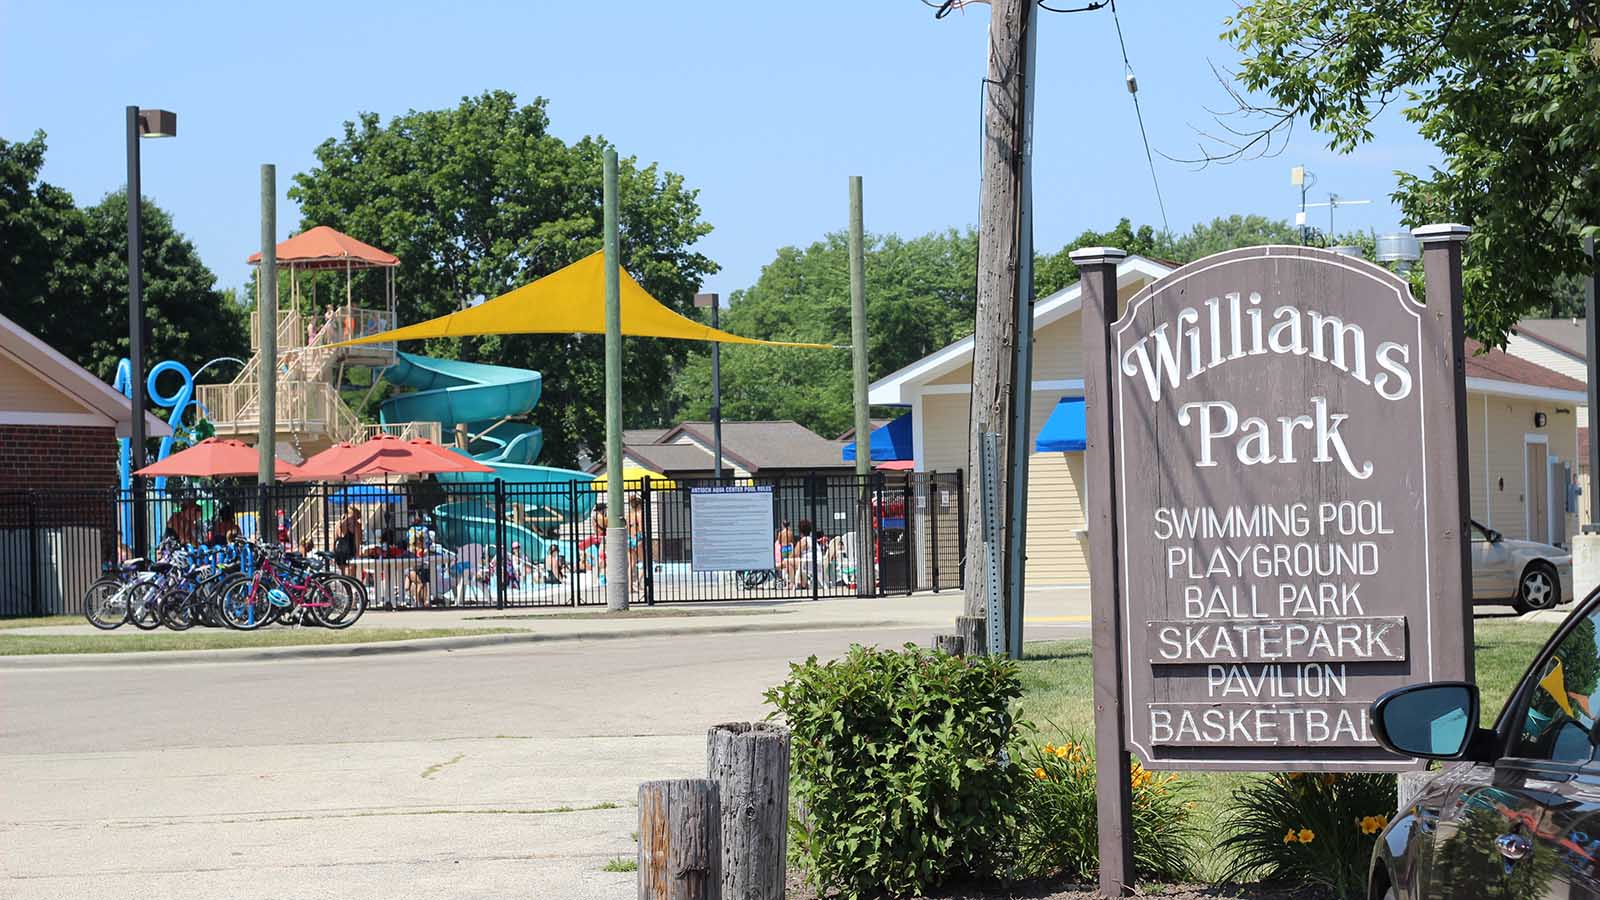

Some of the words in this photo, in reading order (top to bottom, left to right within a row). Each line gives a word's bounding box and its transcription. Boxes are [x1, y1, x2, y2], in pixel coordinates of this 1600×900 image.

[1122, 291, 1412, 402] Williams
[1177, 396, 1374, 480] Park
[1154, 504, 1310, 540] SWIMMING
[1319, 500, 1394, 535] POOL
[1168, 542, 1379, 579] PLAYGROUND
[1184, 584, 1269, 619] BALL
[1279, 582, 1365, 616] PARK
[1158, 622, 1393, 660] SKATEPARK
[1207, 663, 1347, 697] PAVILION
[1151, 708, 1376, 745] BASKETBAL
